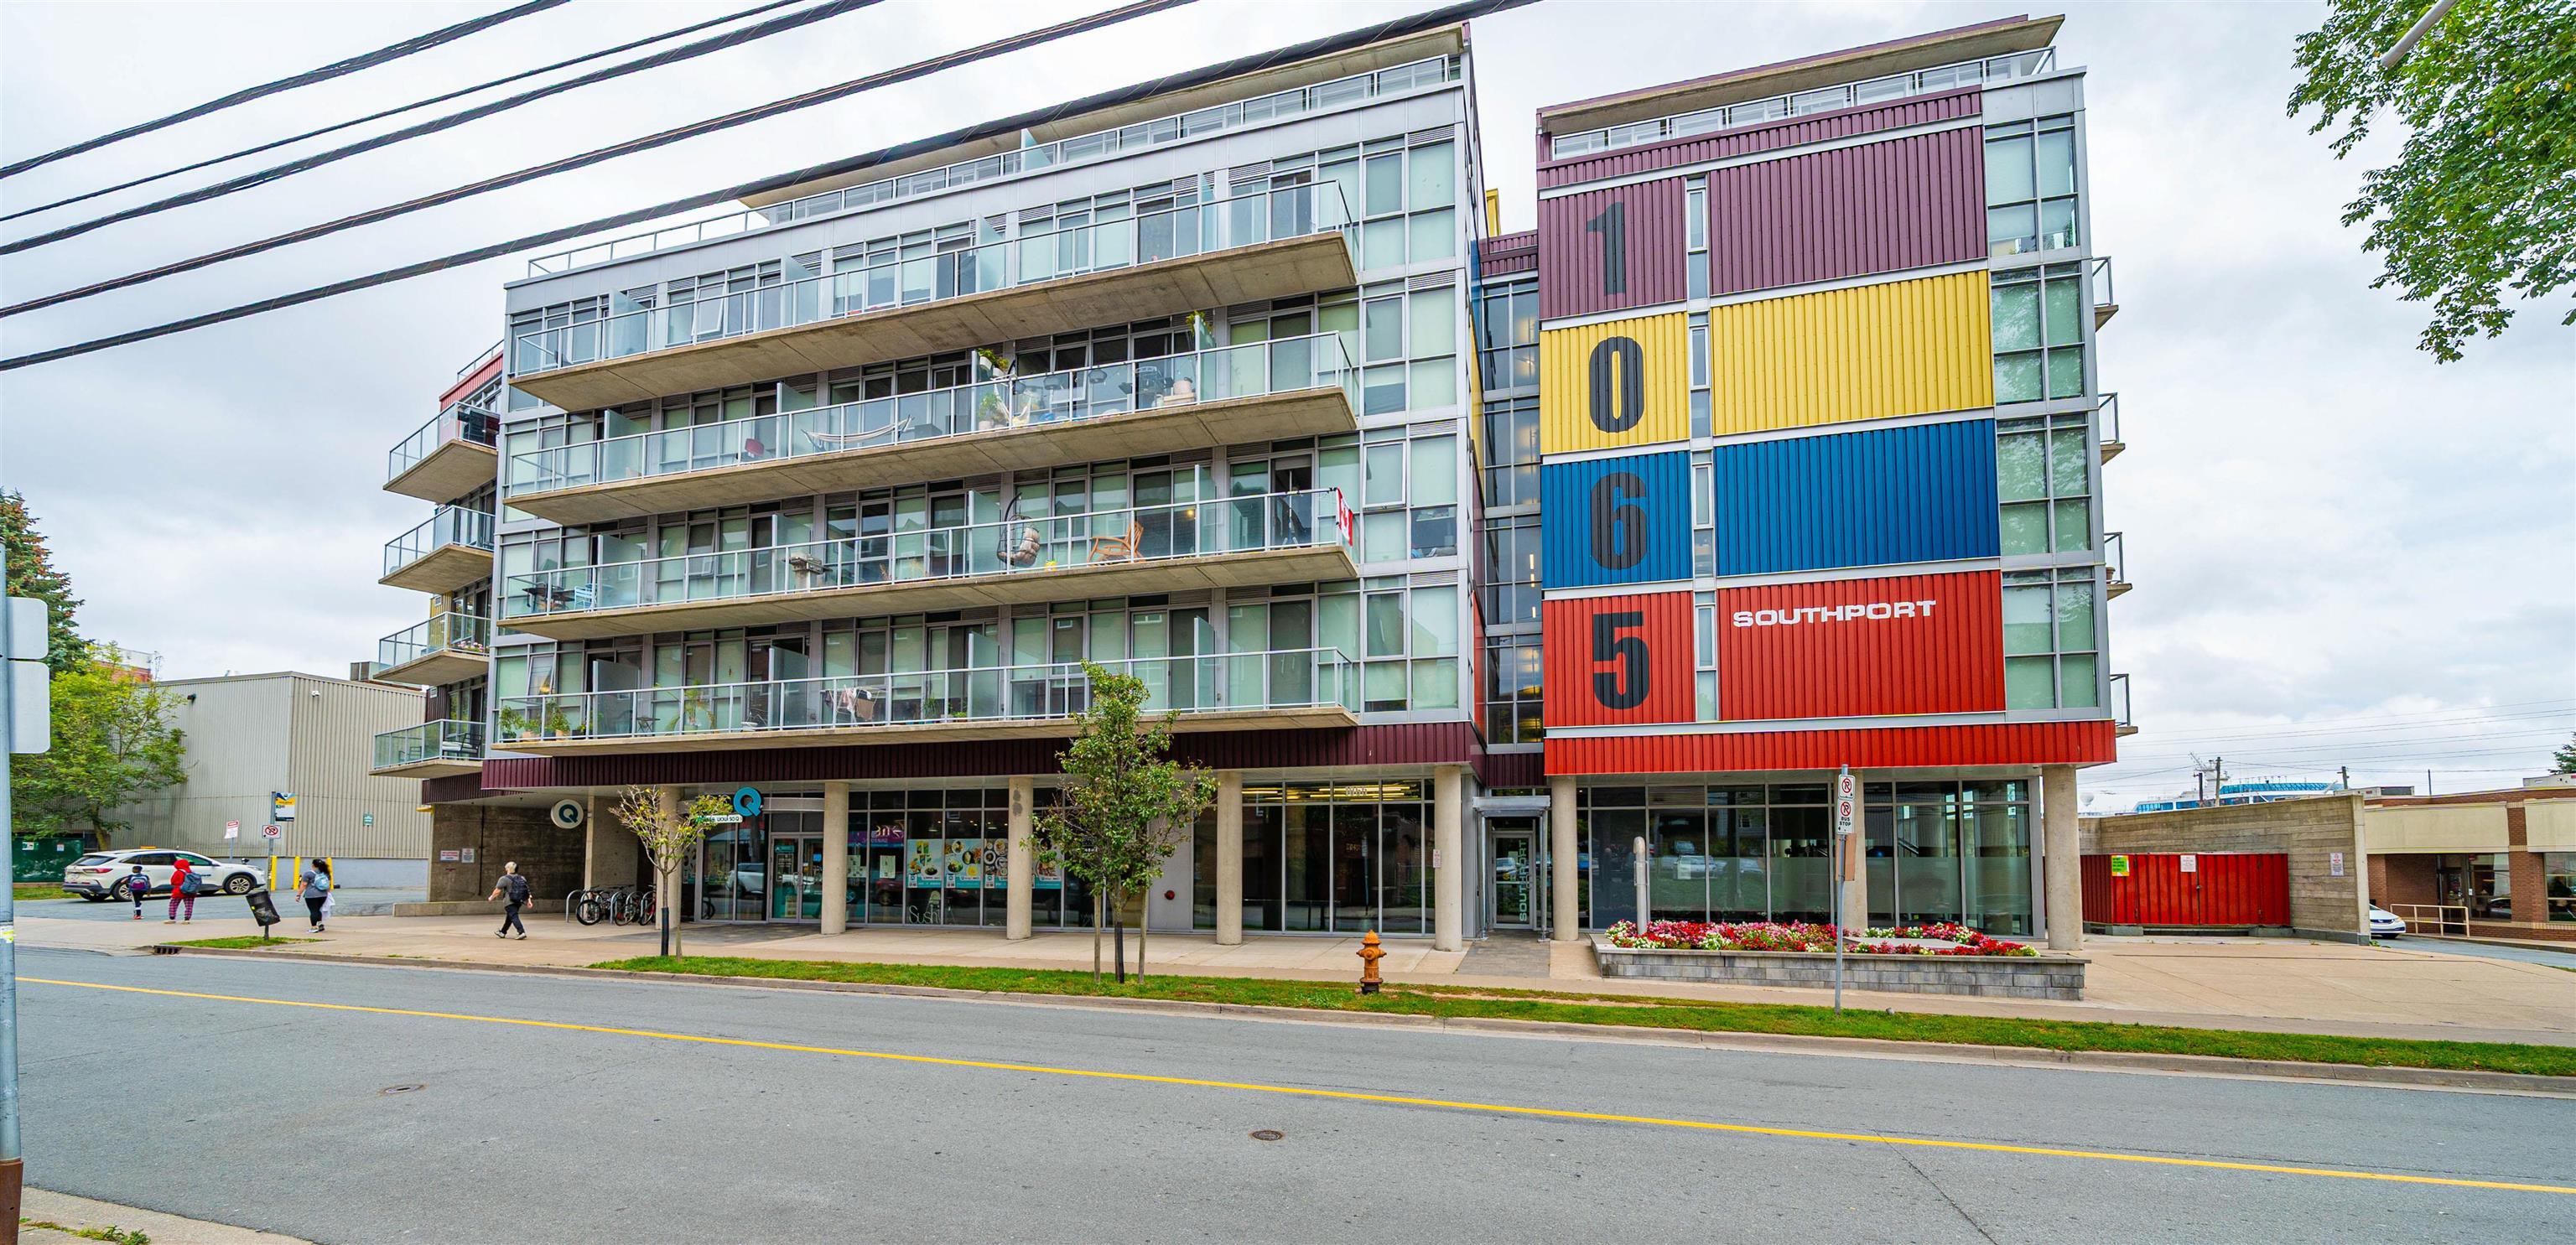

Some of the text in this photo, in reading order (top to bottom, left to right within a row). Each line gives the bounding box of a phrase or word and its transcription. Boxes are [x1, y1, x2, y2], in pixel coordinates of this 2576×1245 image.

[1732, 600, 1936, 627] SOUTHPORT
[558, 804, 579, 823] Q
[734, 786, 761, 817] Q
[1519, 839, 1527, 922] SOUTHPORT
